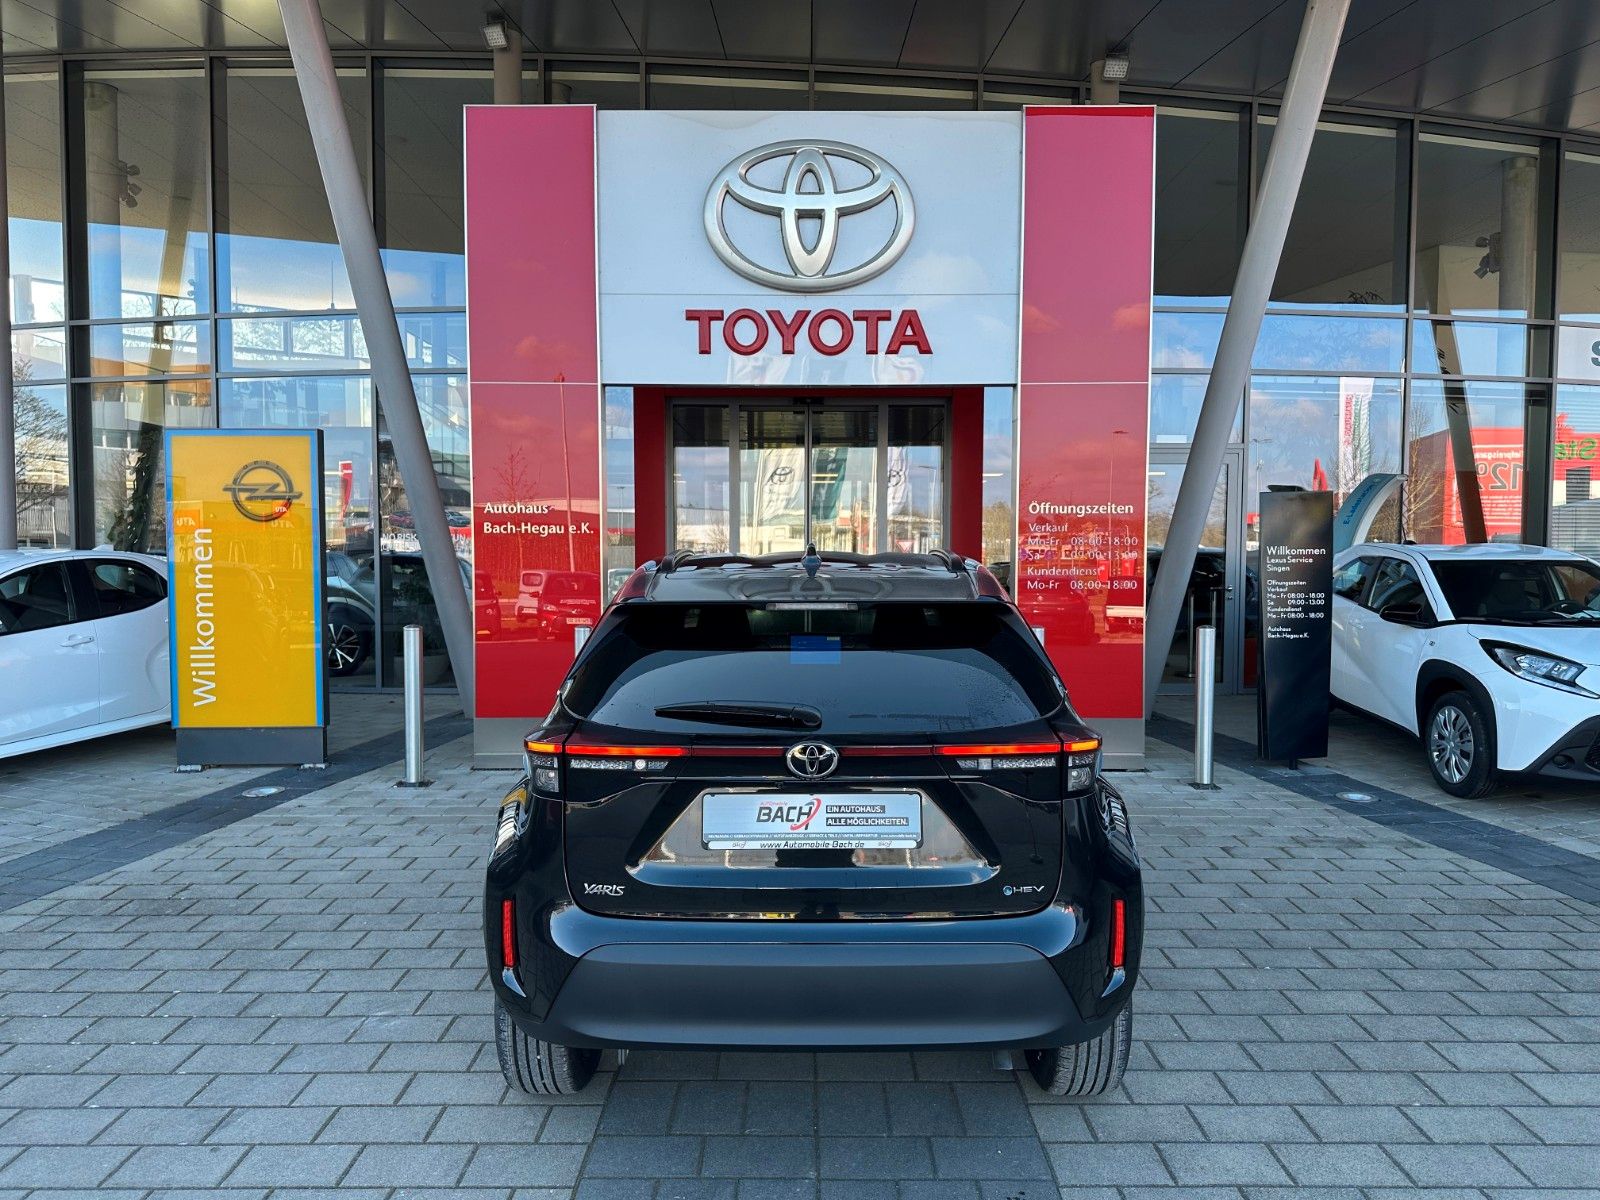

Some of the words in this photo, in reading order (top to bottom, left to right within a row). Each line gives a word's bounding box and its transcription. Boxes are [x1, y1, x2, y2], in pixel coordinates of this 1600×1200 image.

[685, 308, 933, 356] TOYOTA
[483, 502, 549, 514] Autohaus
[1028, 500, 1134, 517] Öffnungszeiten
[483, 522, 565, 537] Bach-Hegau
[569, 522, 594, 534] e.K.
[1028, 522, 1068, 532] Verkauf
[382, 533, 396, 542] NO
[396, 533, 417, 543] RISK
[1027, 536, 1060, 546] Mo-Fr
[1266, 545, 1326, 555] Willkommen
[1027, 566, 1103, 576] Kundendienst
[1266, 564, 1290, 572] Singen
[1027, 580, 1060, 590] Mo-Fr
[1070, 580, 1138, 590] 08:00-18:00
[190, 528, 216, 708] Willkommen
[827, 805, 839, 813] EIN
[840, 805, 883, 813] AUTOHAUS.
[756, 805, 813, 829] BACH
[827, 817, 846, 826] ALLE
[847, 816, 908, 826] MÖGLICHKEITEN.
[583, 882, 626, 897] YARIS
[1013, 885, 1045, 894] HEV
